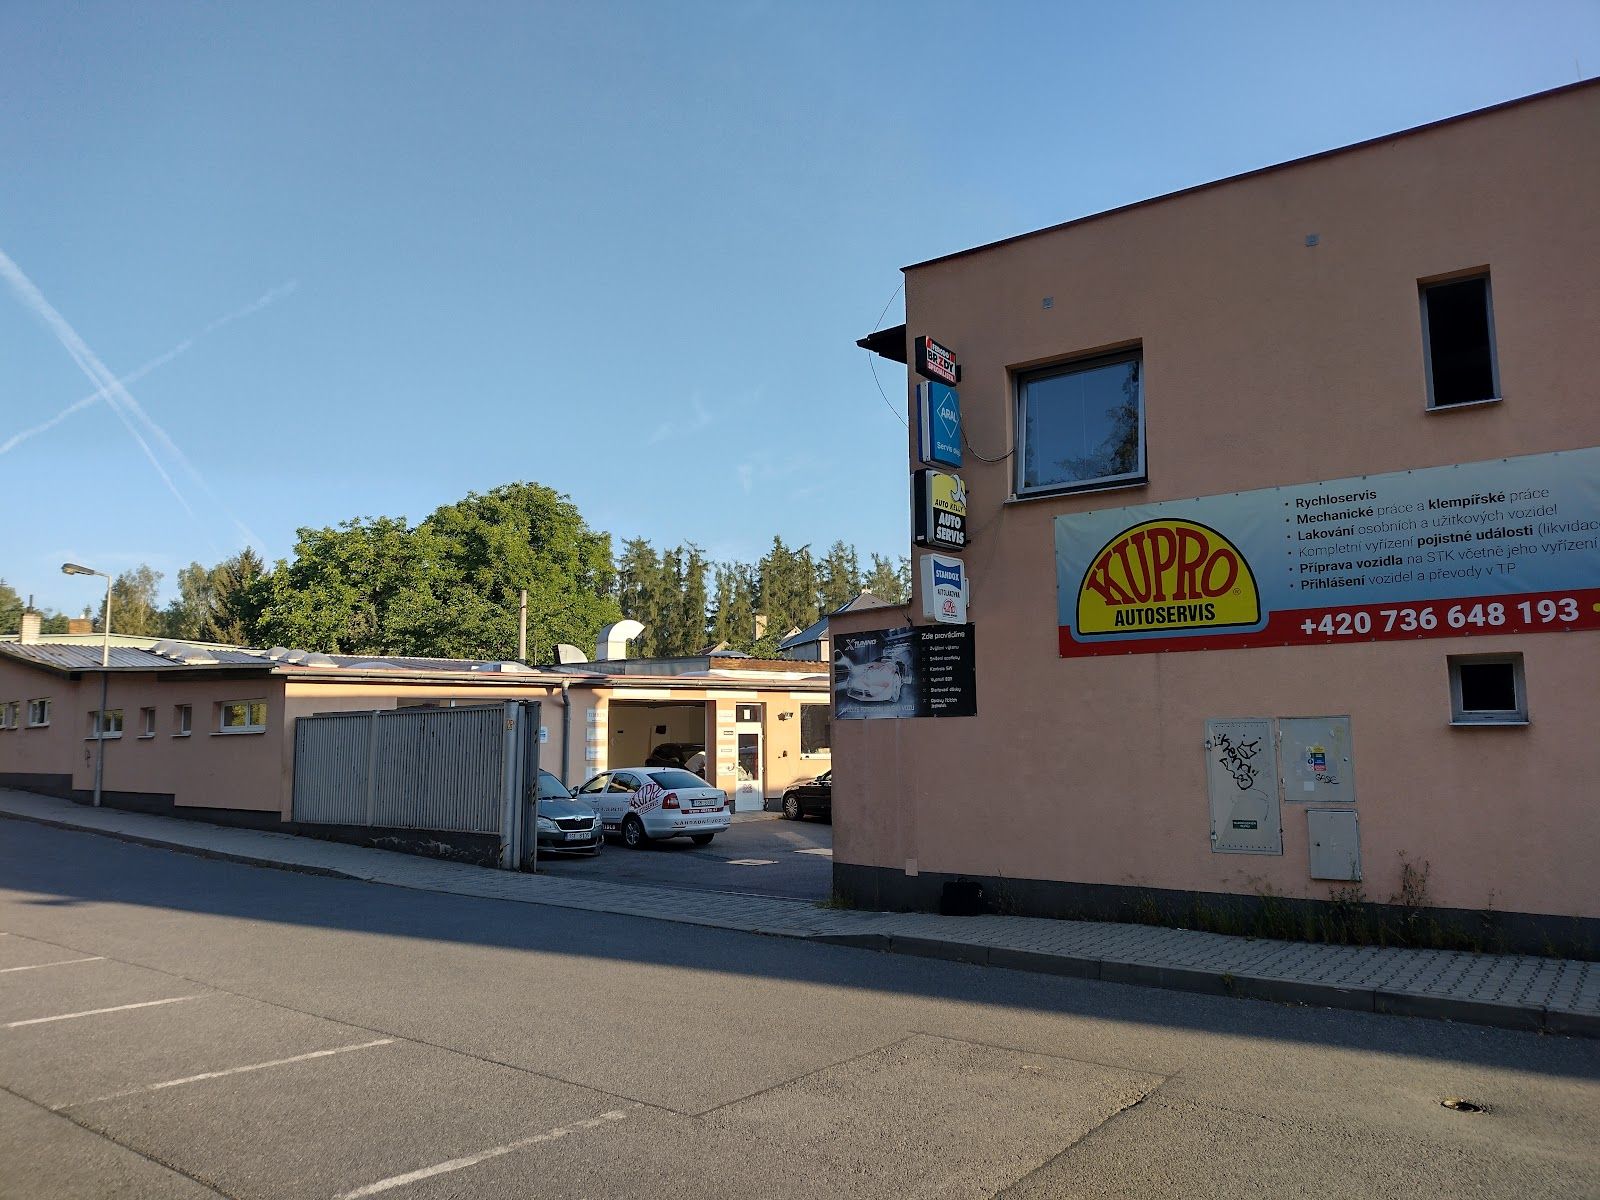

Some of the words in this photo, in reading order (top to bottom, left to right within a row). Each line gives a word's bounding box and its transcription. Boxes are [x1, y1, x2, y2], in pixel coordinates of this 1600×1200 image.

[927, 350, 954, 373] BRZDY
[941, 407, 957, 423] ARAL
[936, 441, 952, 453] Servis
[934, 498, 948, 509] AUTO
[1296, 490, 1377, 509] Rychloservis
[1297, 506, 1374, 524] Mechanické
[1377, 502, 1413, 518] práce
[1416, 502, 1425, 512] a
[1428, 491, 1506, 510] klempířské
[1510, 488, 1550, 504] práce
[938, 512, 962, 529] AUTO
[1298, 525, 1354, 541] Lakování
[1358, 517, 1417, 535] osobních
[1420, 519, 1429, 529] a
[1432, 510, 1504, 527] užitkových
[1507, 504, 1558, 520] vozidel
[936, 526, 965, 545] SERVIS
[1299, 541, 1362, 558] Kompletní
[1364, 536, 1414, 554] vyřízení
[1417, 531, 1472, 549] pojistné
[1476, 524, 1534, 540] události
[1538, 519, 1600, 538] (likvidac
[1085, 527, 1239, 606] KUPRO
[1300, 560, 1353, 575] Příprava
[1356, 555, 1403, 569] vozidla
[1407, 555, 1423, 565] na
[1427, 550, 1455, 563] STK
[1458, 546, 1504, 561] včetně
[1506, 543, 1538, 559] jeho
[1541, 536, 1598, 555] vyřízení
[936, 569, 960, 582] STANDOX
[1301, 574, 1365, 591] Přihlášení
[1369, 573, 1413, 586] vozidel
[1417, 571, 1425, 581] a
[1429, 565, 1482, 583] převody
[1486, 566, 1494, 576] v
[1497, 562, 1517, 575] TP
[1114, 603, 1216, 627] AUTOSERVIS
[1300, 611, 1371, 636] +420
[1380, 607, 1438, 632] 736
[1447, 602, 1506, 628] 648
[1517, 598, 1580, 624] 193
[921, 632, 934, 641] Zde
[934, 630, 966, 640] provádíme
